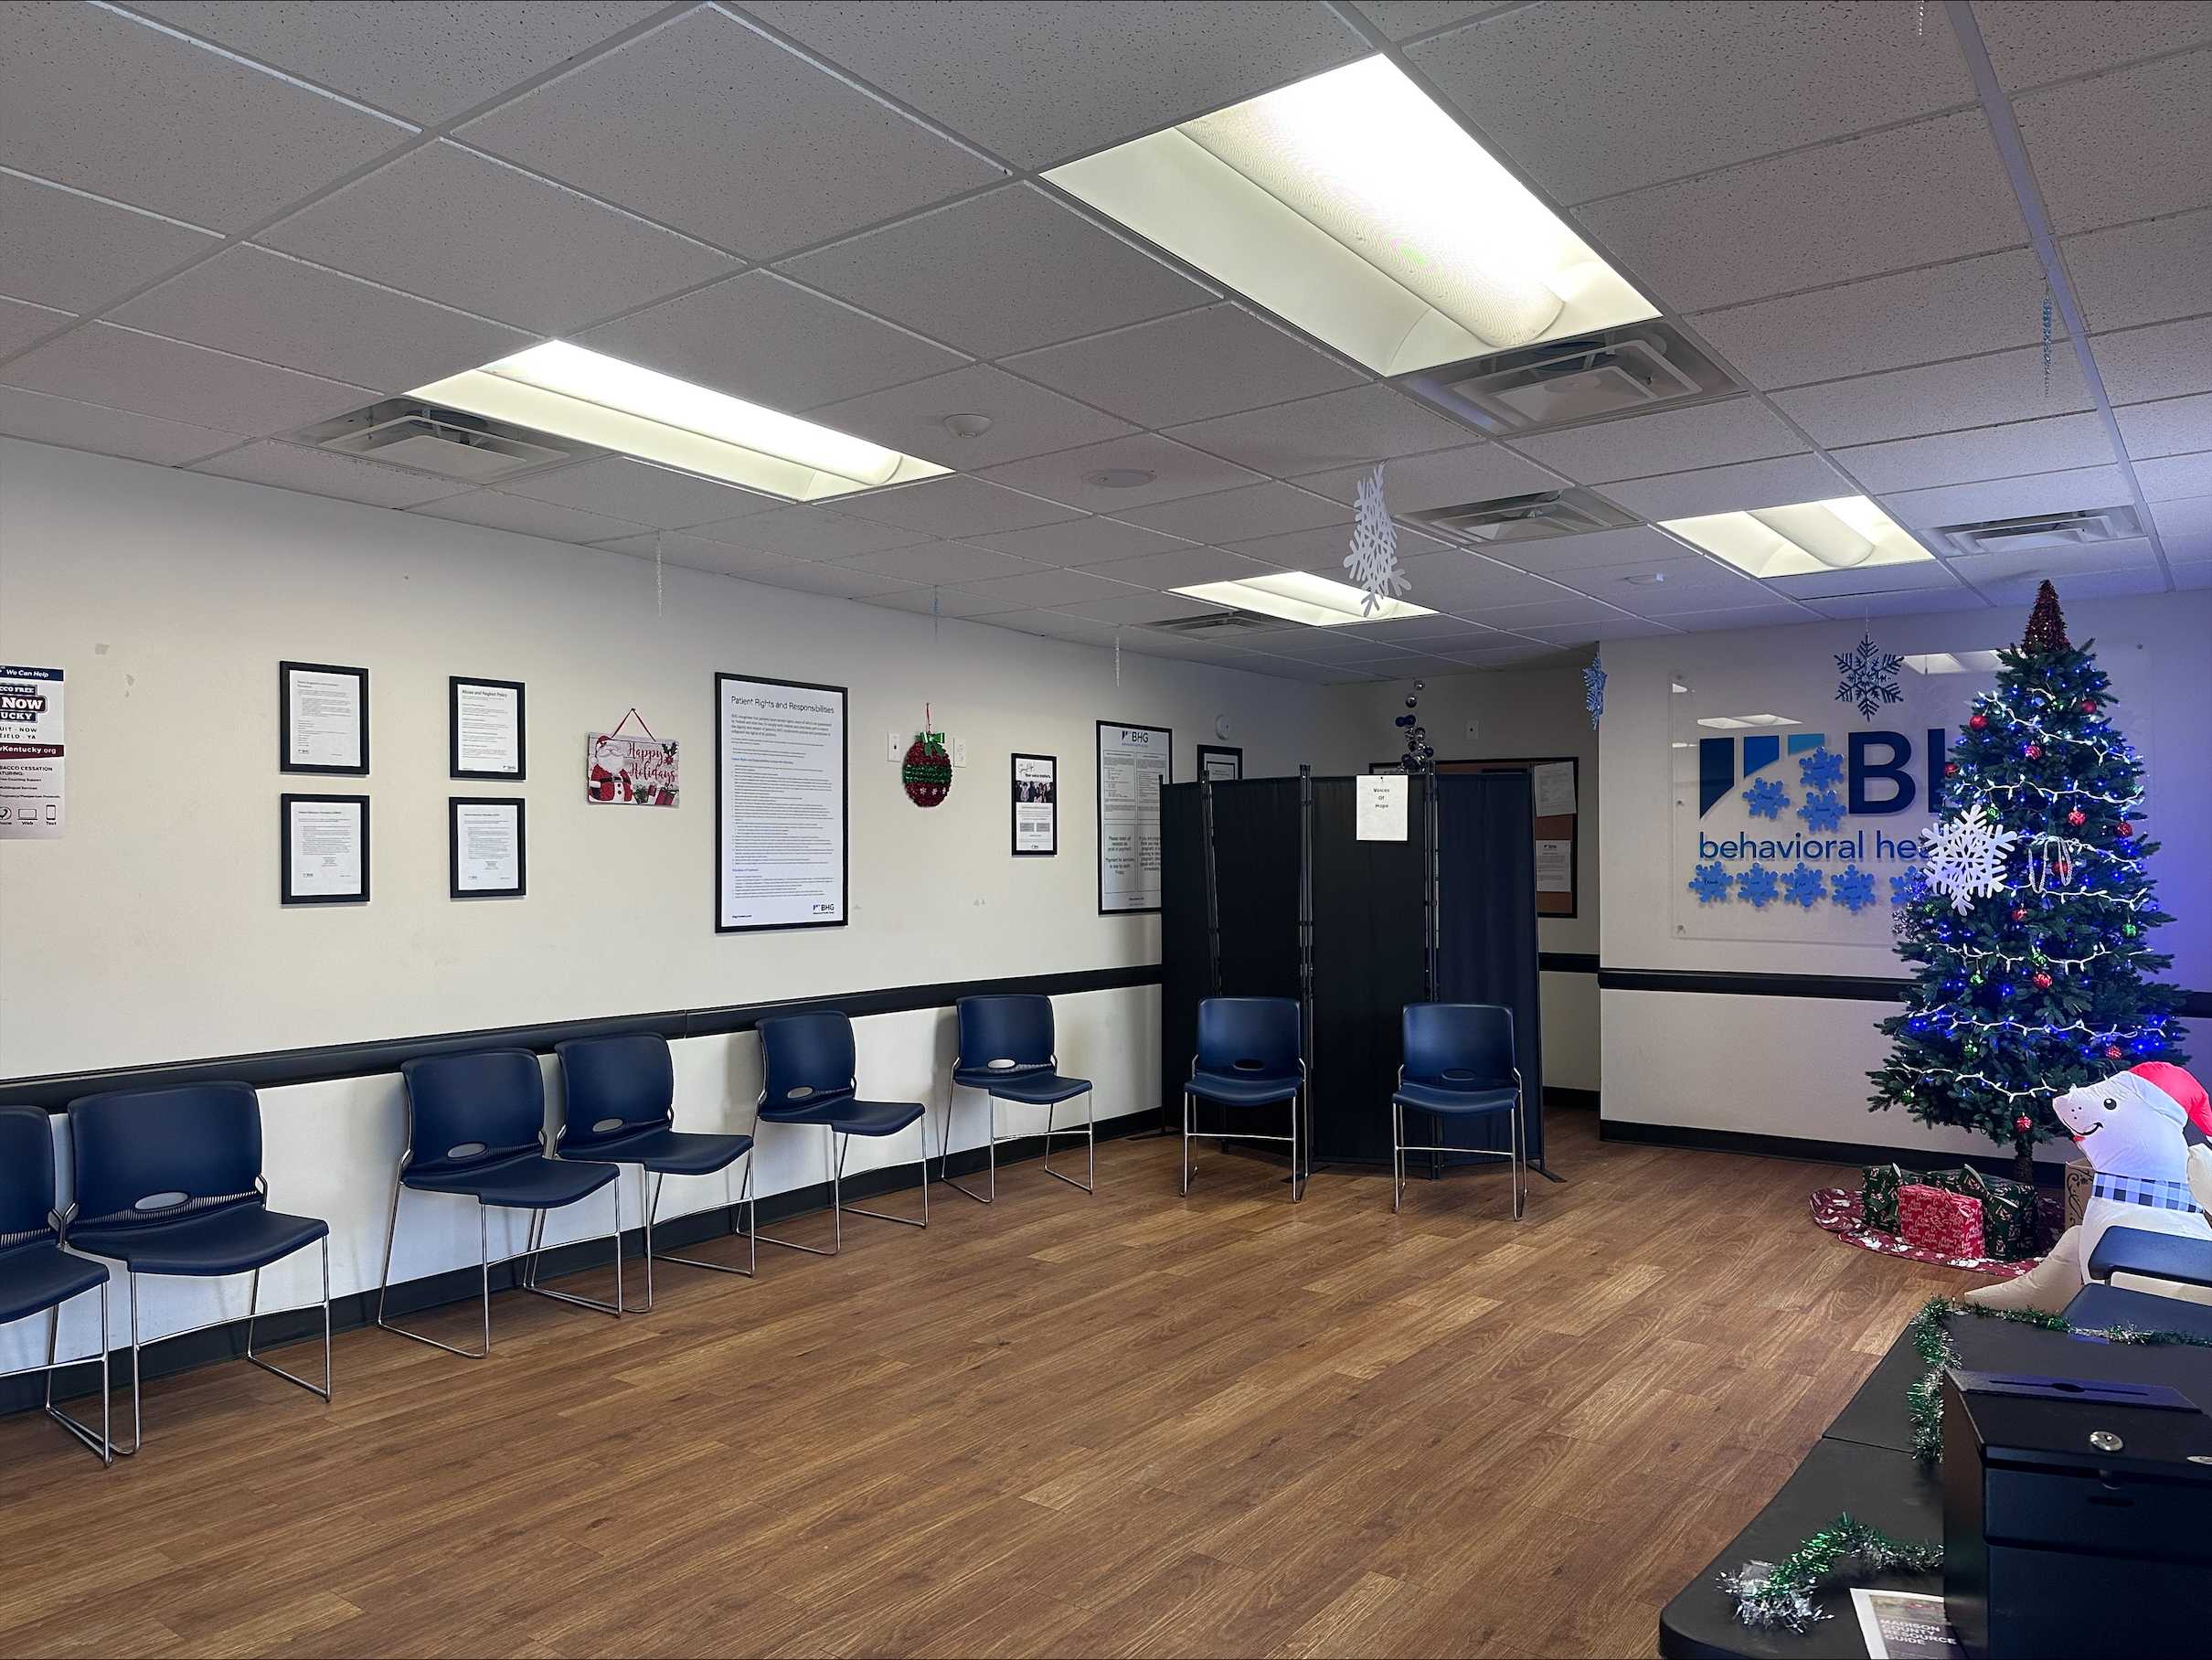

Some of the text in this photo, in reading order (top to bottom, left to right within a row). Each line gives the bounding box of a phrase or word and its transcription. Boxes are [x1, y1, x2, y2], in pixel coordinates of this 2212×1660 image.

[2, 697, 43, 709] NOW
[731, 696, 835, 714] Patient Rights and Responsibilities
[1132, 731, 1149, 743] BHG
[626, 741, 663, 767] Happy
[630, 761, 675, 789] Holidays
[1699, 830, 1863, 859] behavioral
[821, 903, 835, 911] BHG
[1879, 1619, 1941, 1633] MADISON
[1881, 1623, 1936, 1636] COUNTY
[1883, 1629, 1958, 1644] RESOURCE
[1885, 1634, 1926, 1645] GUIDE
